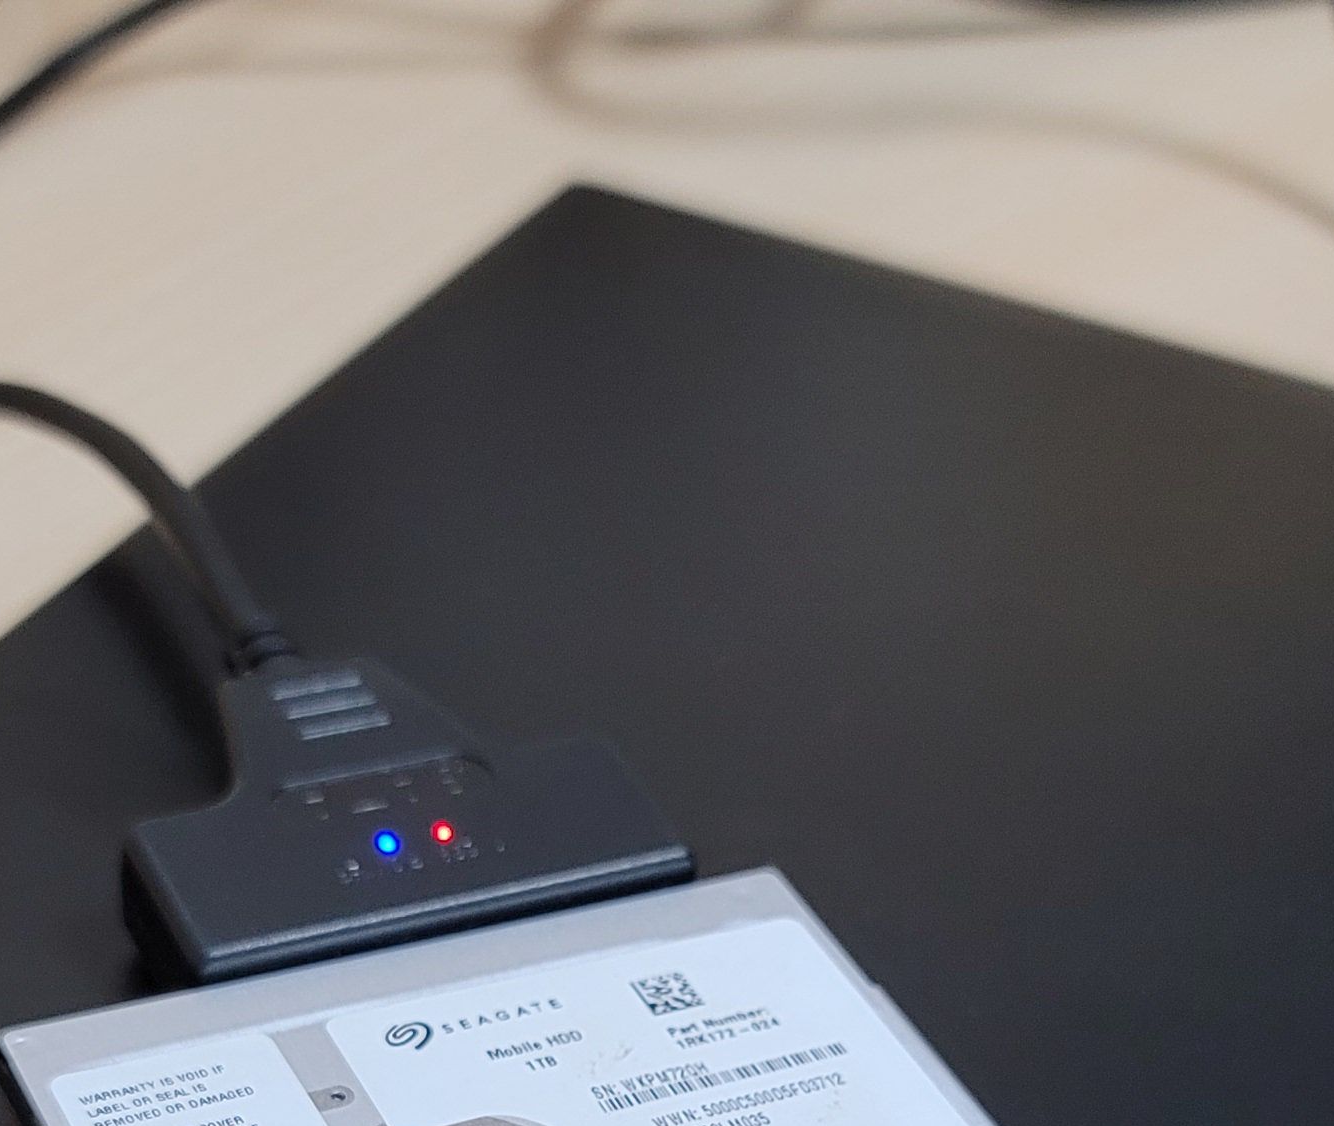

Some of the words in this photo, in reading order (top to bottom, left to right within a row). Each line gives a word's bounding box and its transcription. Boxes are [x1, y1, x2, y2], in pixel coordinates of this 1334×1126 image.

[441, 998, 563, 1034] SEAGATE
[667, 1021, 700, 1038] Part
[487, 1041, 543, 1060] Mobile
[545, 1030, 583, 1048] HDD
[525, 1056, 558, 1072] 1TB
[79, 1081, 155, 1106] WARRANTY
[160, 1077, 175, 1088] IS
[176, 1069, 209, 1084] VOID
[212, 1065, 225, 1076] IF
[165, 1102, 185, 1114] OR
[189, 1086, 255, 1109] DAMAGED
[87, 1102, 131, 1118] LABEL
[133, 1096, 152, 1108] OR
[155, 1089, 190, 1102] SEAL
[193, 1084, 208, 1093] IS
